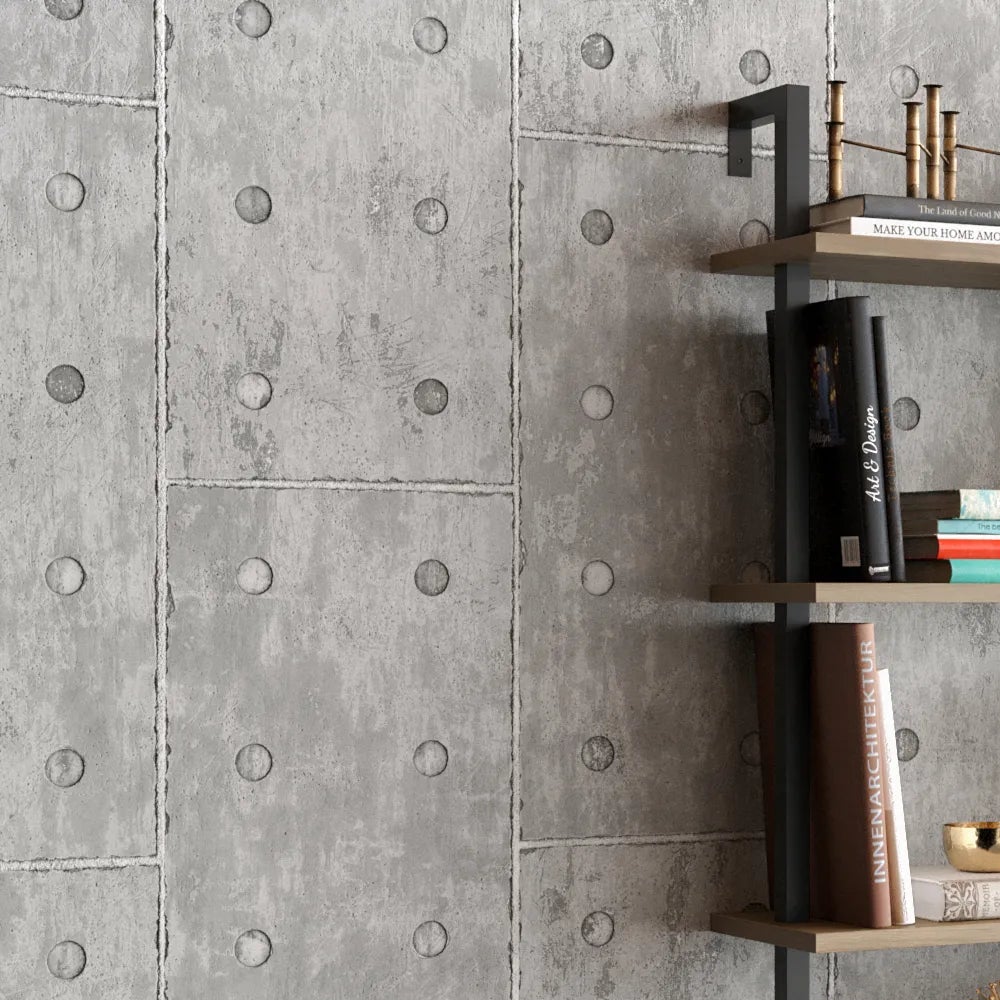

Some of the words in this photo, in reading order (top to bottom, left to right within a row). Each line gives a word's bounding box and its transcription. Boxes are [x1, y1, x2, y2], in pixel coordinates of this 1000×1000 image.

[918, 204, 935, 215] The
[936, 205, 958, 217] Land
[959, 206, 969, 217] of
[969, 208, 992, 219] Good
[873, 223, 905, 236] MAKE
[907, 225, 938, 238] YOUR
[940, 228, 975, 241] HOME
[861, 404, 881, 454] Design
[863, 458, 880, 474] &
[864, 471, 882, 503] Art
[860, 640, 886, 884] INNENARCHITEKTUR
